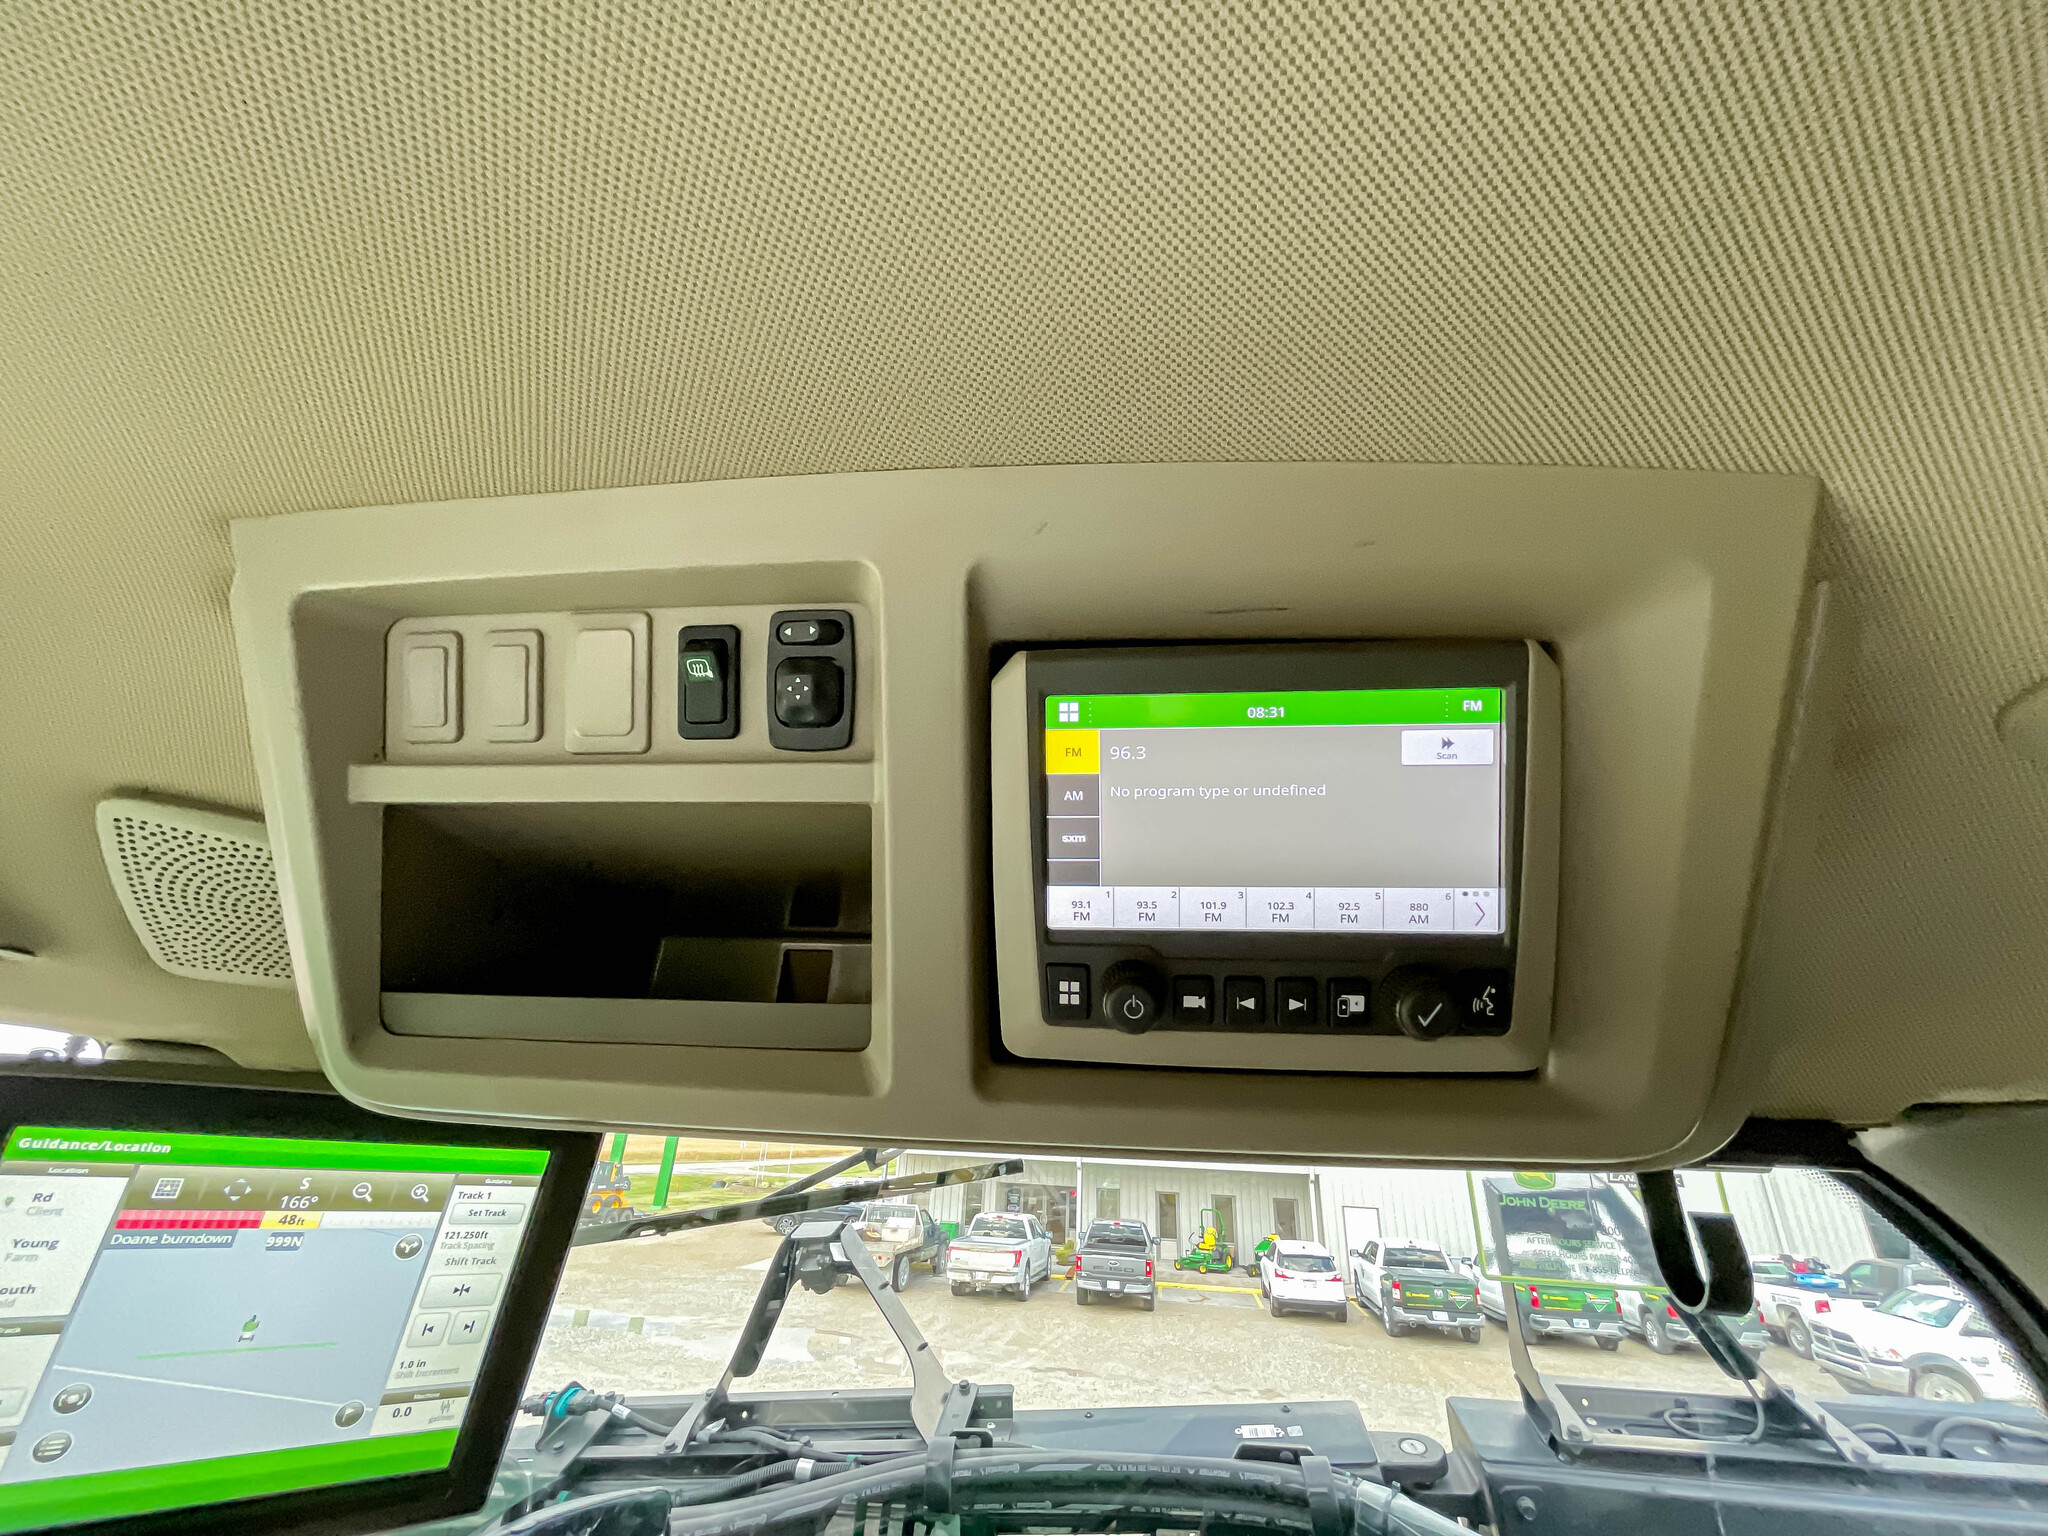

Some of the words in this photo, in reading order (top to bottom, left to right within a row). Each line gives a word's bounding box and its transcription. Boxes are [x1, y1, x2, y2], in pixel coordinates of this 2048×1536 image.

[1462, 699, 1483, 711] FM
[1246, 706, 1285, 719] 08:31
[1065, 747, 1082, 757] FM
[1110, 746, 1147, 760] 96.3
[1436, 752, 1458, 760] Scan
[1063, 790, 1084, 801] AM
[1110, 786, 1130, 797] No
[1134, 786, 1195, 800] program
[1199, 786, 1230, 800] type
[1233, 786, 1249, 796] or
[1253, 784, 1327, 796] undefined
[1061, 834, 1086, 843] sxm
[1106, 890, 1111, 899] 1
[1171, 890, 1177, 899] 2
[1237, 891, 1244, 899] 3
[1305, 892, 1312, 900] 4
[1375, 892, 1381, 900] 5
[1445, 893, 1452, 901] 6
[1071, 900, 1092, 909] 93.1
[1136, 901, 1158, 910] 93.5
[1200, 901, 1227, 910] 101.9
[1267, 902, 1295, 911] 102.3
[1338, 902, 1361, 911] 92.5
[1409, 902, 1429, 911] 880
[1073, 912, 1091, 921] FM
[1138, 912, 1156, 922] FM
[1204, 913, 1222, 922] FM
[1271, 913, 1290, 923] FM
[1340, 914, 1358, 924] FM
[1408, 914, 1429, 924] AM
[18, 1136, 172, 1154] Guidance/Location
[299, 1177, 312, 1190] S
[32, 1192, 54, 1203] Rd
[458, 1191, 484, 1200] Track
[486, 1191, 492, 1200] 1
[280, 1195, 319, 1209] 166°
[1499, 1194, 1537, 1208] JOHN
[1538, 1196, 1586, 1211] DEERE
[25, 1206, 64, 1217] Client
[468, 1209, 482, 1217] Set
[484, 1209, 507, 1217] Track
[110, 1233, 157, 1245] Doane
[161, 1233, 233, 1245] burndown
[444, 1231, 489, 1240] 121.250ft
[12, 1238, 60, 1251] Young
[440, 1242, 462, 1250] Track
[463, 1242, 496, 1251] Spacing
[4, 1252, 39, 1263] Farm
[445, 1258, 469, 1266] Shift
[471, 1257, 497, 1265] Track
[0, 1284, 36, 1295] outh
[400, 1360, 415, 1370] 1.0
[416, 1359, 427, 1368] in
[392, 1406, 412, 1419] 0.0
